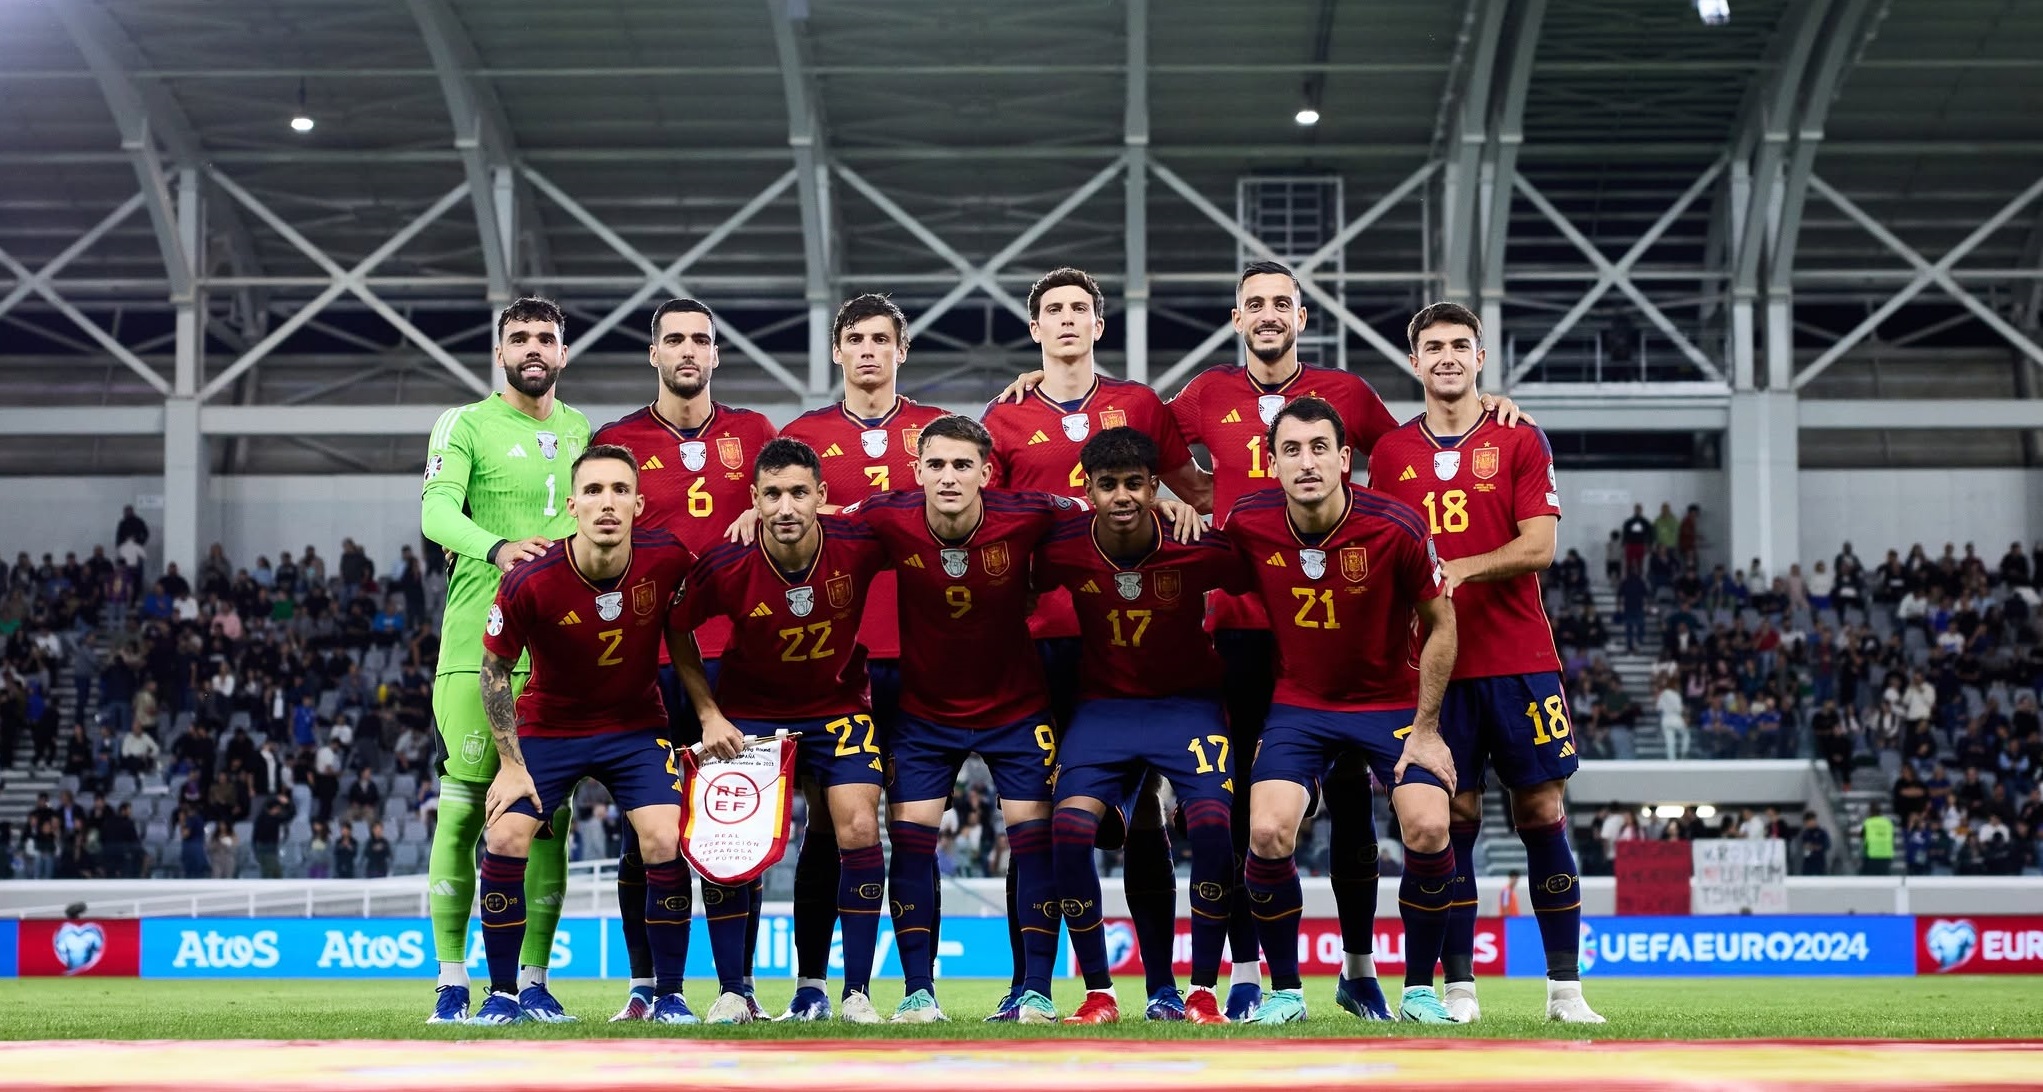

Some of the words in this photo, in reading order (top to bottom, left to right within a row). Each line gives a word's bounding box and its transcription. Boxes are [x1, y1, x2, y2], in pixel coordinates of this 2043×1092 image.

[1246, 435, 1276, 478] 1
[543, 474, 557, 517] 1
[687, 476, 713, 518] 6
[1422, 489, 1469, 534] 18
[945, 586, 972, 619] 9
[1292, 587, 1341, 630] 21
[597, 628, 623, 666] 2
[779, 620, 835, 662] 22
[1107, 609, 1152, 647] 17
[825, 714, 881, 757] 22
[1525, 695, 1571, 745] 18
[656, 738, 679, 777] 2
[1034, 724, 1056, 766] 9
[1188, 735, 1230, 774] 17
[465, 929, 573, 969] AS
